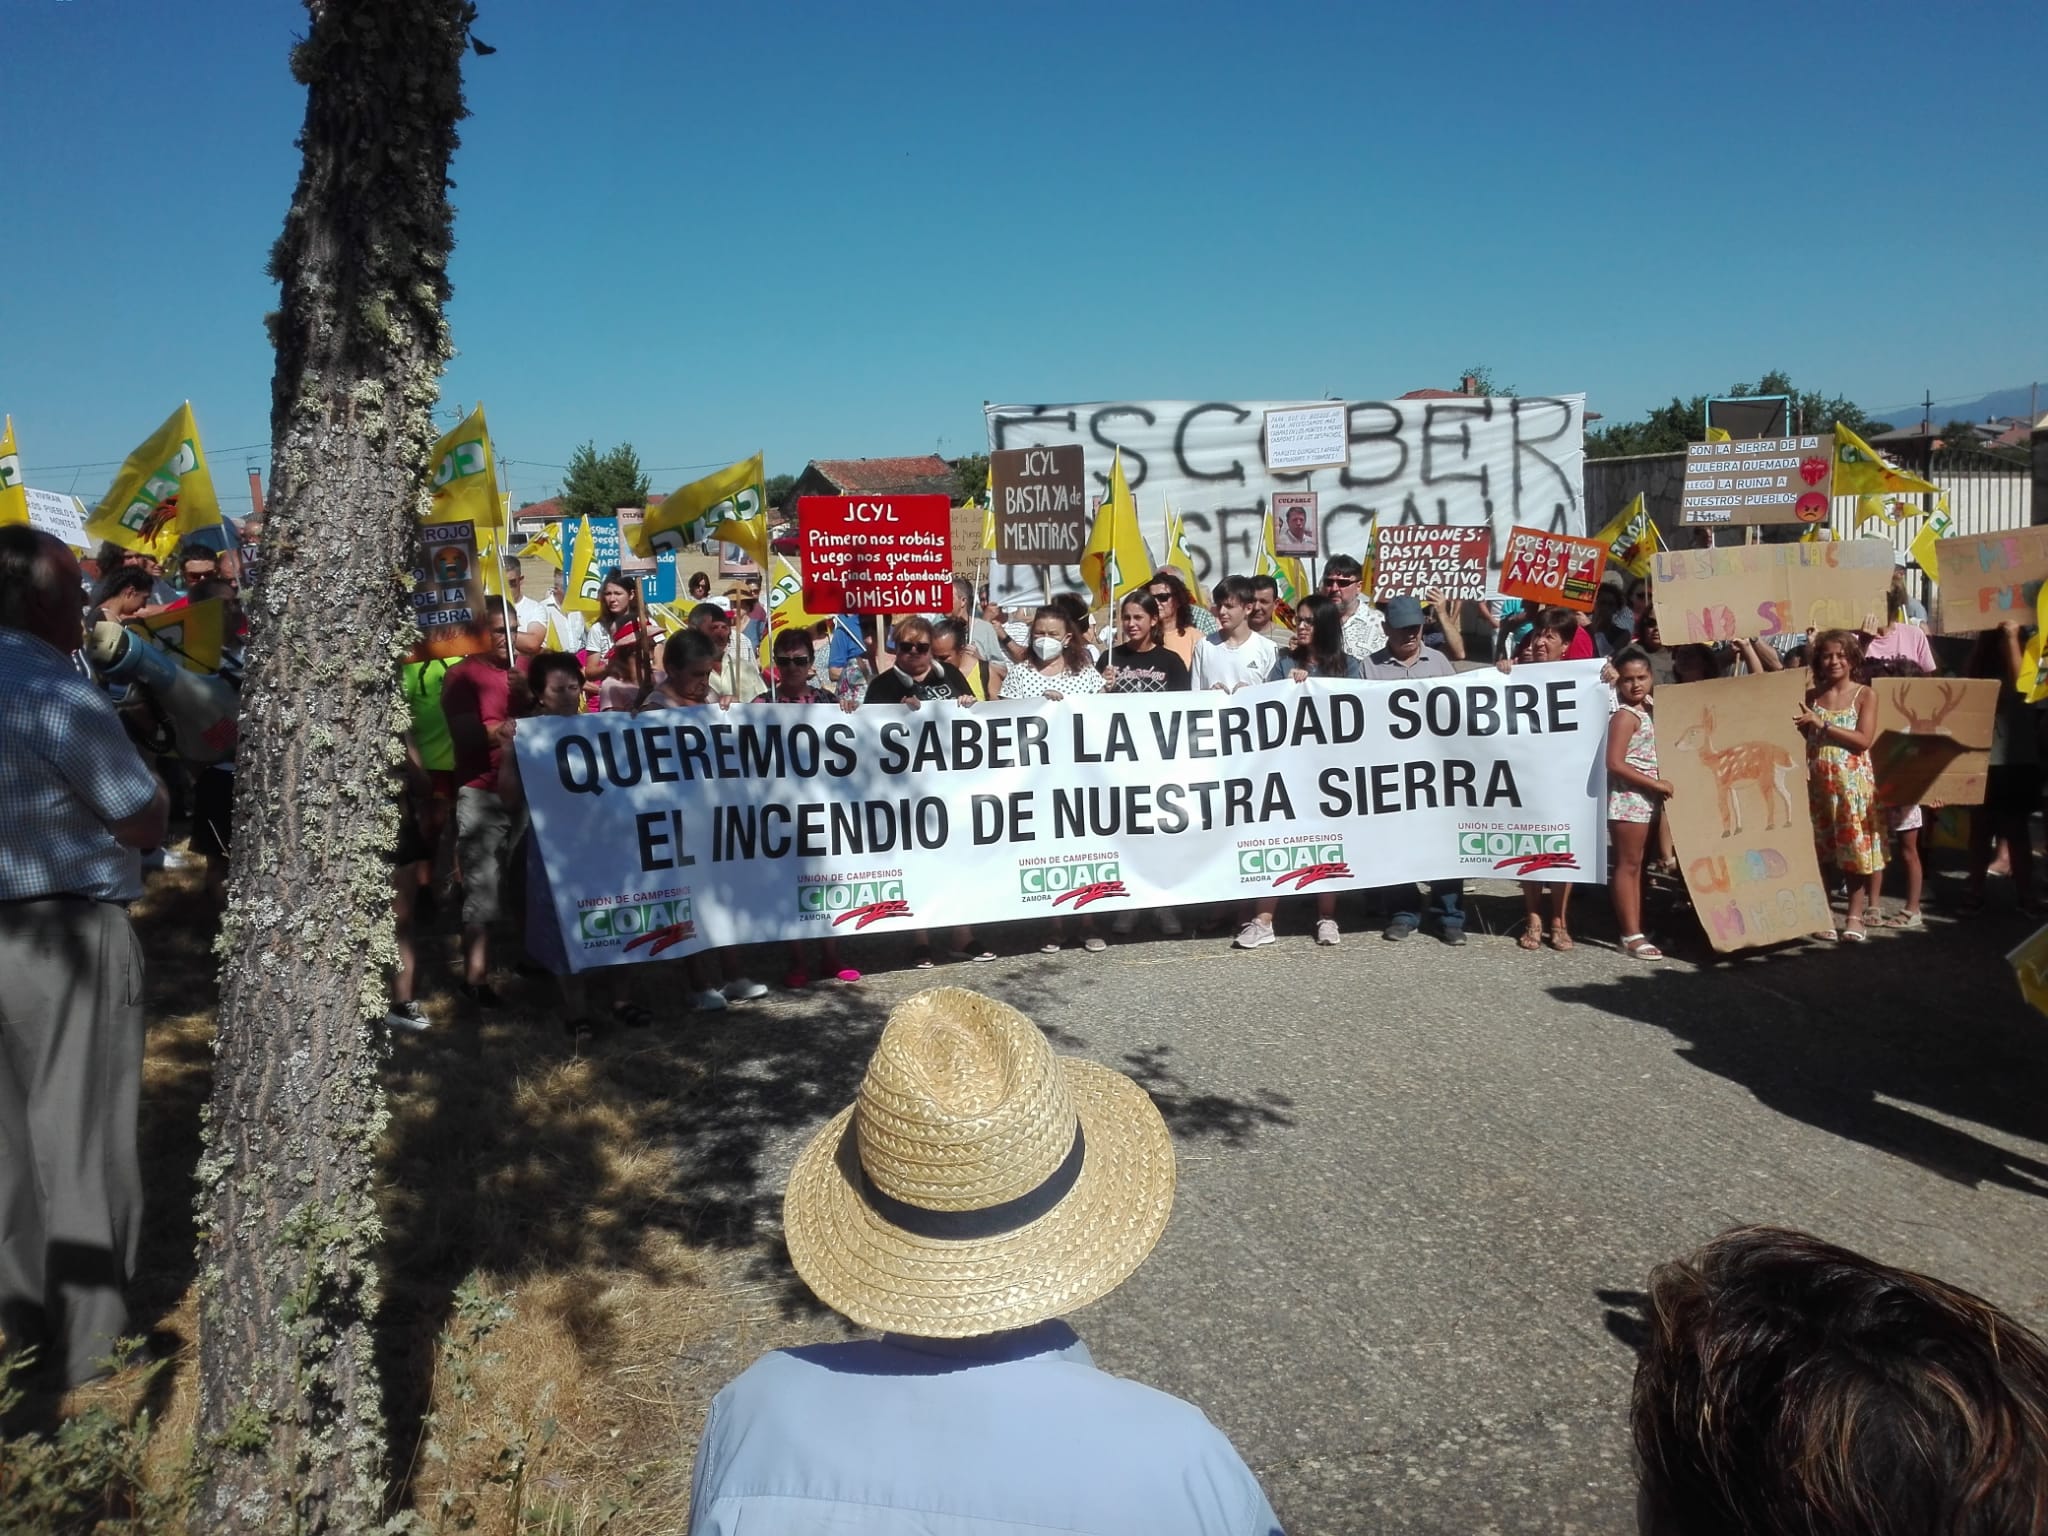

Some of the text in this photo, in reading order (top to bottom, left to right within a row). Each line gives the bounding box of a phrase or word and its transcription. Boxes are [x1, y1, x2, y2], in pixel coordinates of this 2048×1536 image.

[1689, 437, 1817, 455] CON LA SIERRA DE LA
[995, 396, 1577, 520] SCBER
[1020, 450, 1059, 476] JCYL
[1688, 458, 1798, 472] CULEBRA QUEMADA
[1718, 480, 1732, 489] LA
[1737, 478, 1771, 488] RUINA
[1778, 477, 1786, 485] A
[1006, 485, 1081, 514] BASTA YA de
[1685, 494, 1796, 506] NUESTROS PUEBLOS
[843, 502, 899, 522] JCYL
[426, 525, 471, 540] ROJO
[809, 530, 945, 547] Primero nos robáis
[811, 551, 853, 566] Luego
[857, 553, 881, 563] nos
[886, 549, 943, 570] quemáis
[1380, 544, 1461, 560] BASTA DE
[1380, 558, 1485, 572] INSULTOS AL
[1513, 549, 1590, 573] TODO EL
[874, 572, 893, 582] nos
[1378, 571, 1481, 586] OPERATIVO
[444, 589, 465, 602] LA
[1373, 586, 1384, 602] Y
[1411, 585, 1485, 602] METIRAS
[418, 608, 471, 626] LEBRA
[555, 681, 1578, 796] QUEREMOS SABER LA VERDAD SOBRE
[636, 759, 1523, 872] EL INCENDIO DE NUESTRA SIERRA
[1507, 823, 1571, 831] CAMPESINOS
[1283, 833, 1343, 844] CAMPESINOS
[1461, 833, 1567, 856] COAG
[1049, 855, 1060, 864] DE
[1063, 851, 1119, 862] CAMPESINOS
[1241, 845, 1341, 873] COAG
[847, 869, 903, 880] CAMPESINOS
[1023, 863, 1118, 892] COAG
[1240, 875, 1271, 883] ZAMORA
[615, 895, 630, 904] DE
[801, 881, 902, 911] COAG
[1021, 894, 1052, 902] ZAMORA
[583, 899, 691, 937] COAG
[800, 913, 831, 921] ZAMORA
[584, 939, 621, 949] ZAMORA
